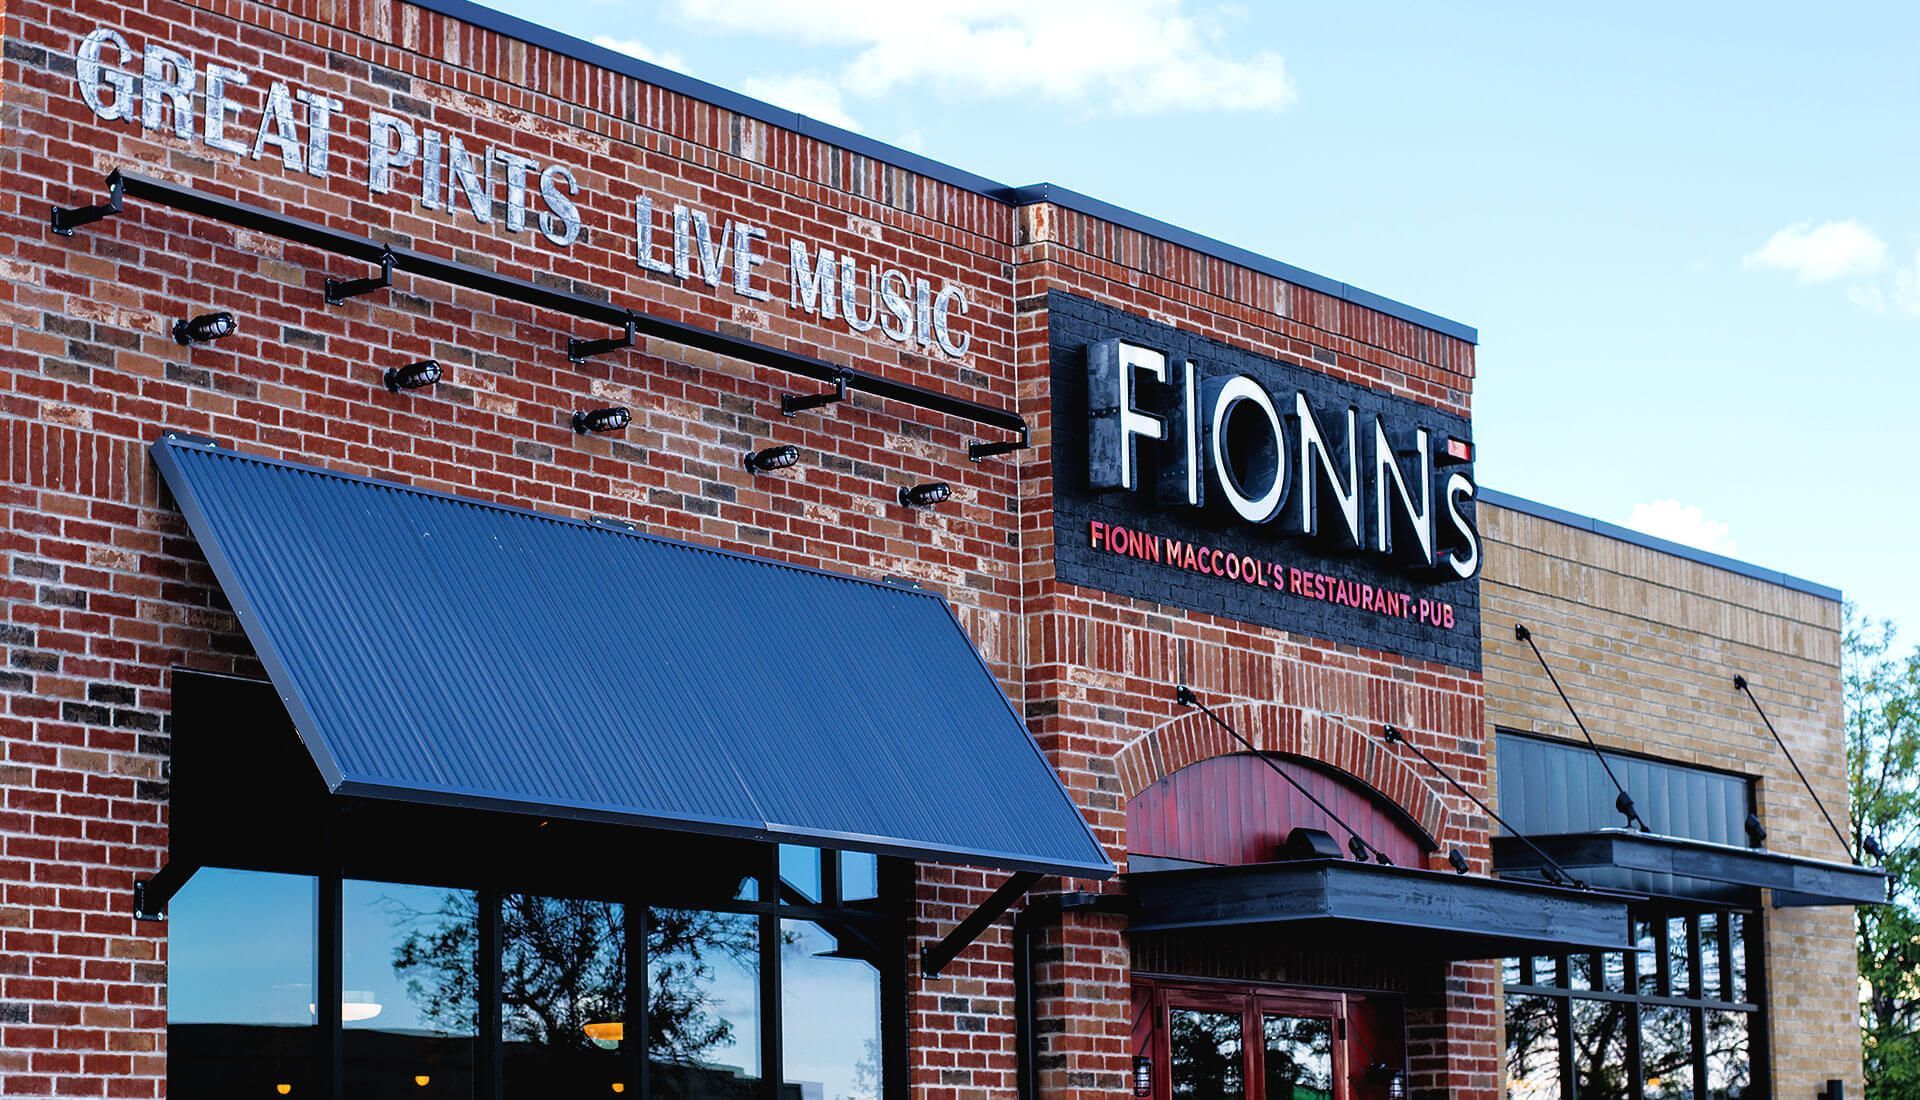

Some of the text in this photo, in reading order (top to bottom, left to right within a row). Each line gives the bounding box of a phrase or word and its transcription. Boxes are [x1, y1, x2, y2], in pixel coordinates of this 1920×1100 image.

[76, 28, 971, 358] GREAT PINTS LIVE MUSIC
[1090, 520, 1160, 563] FIONN
[1166, 538, 1285, 591] MACCOOL'S
